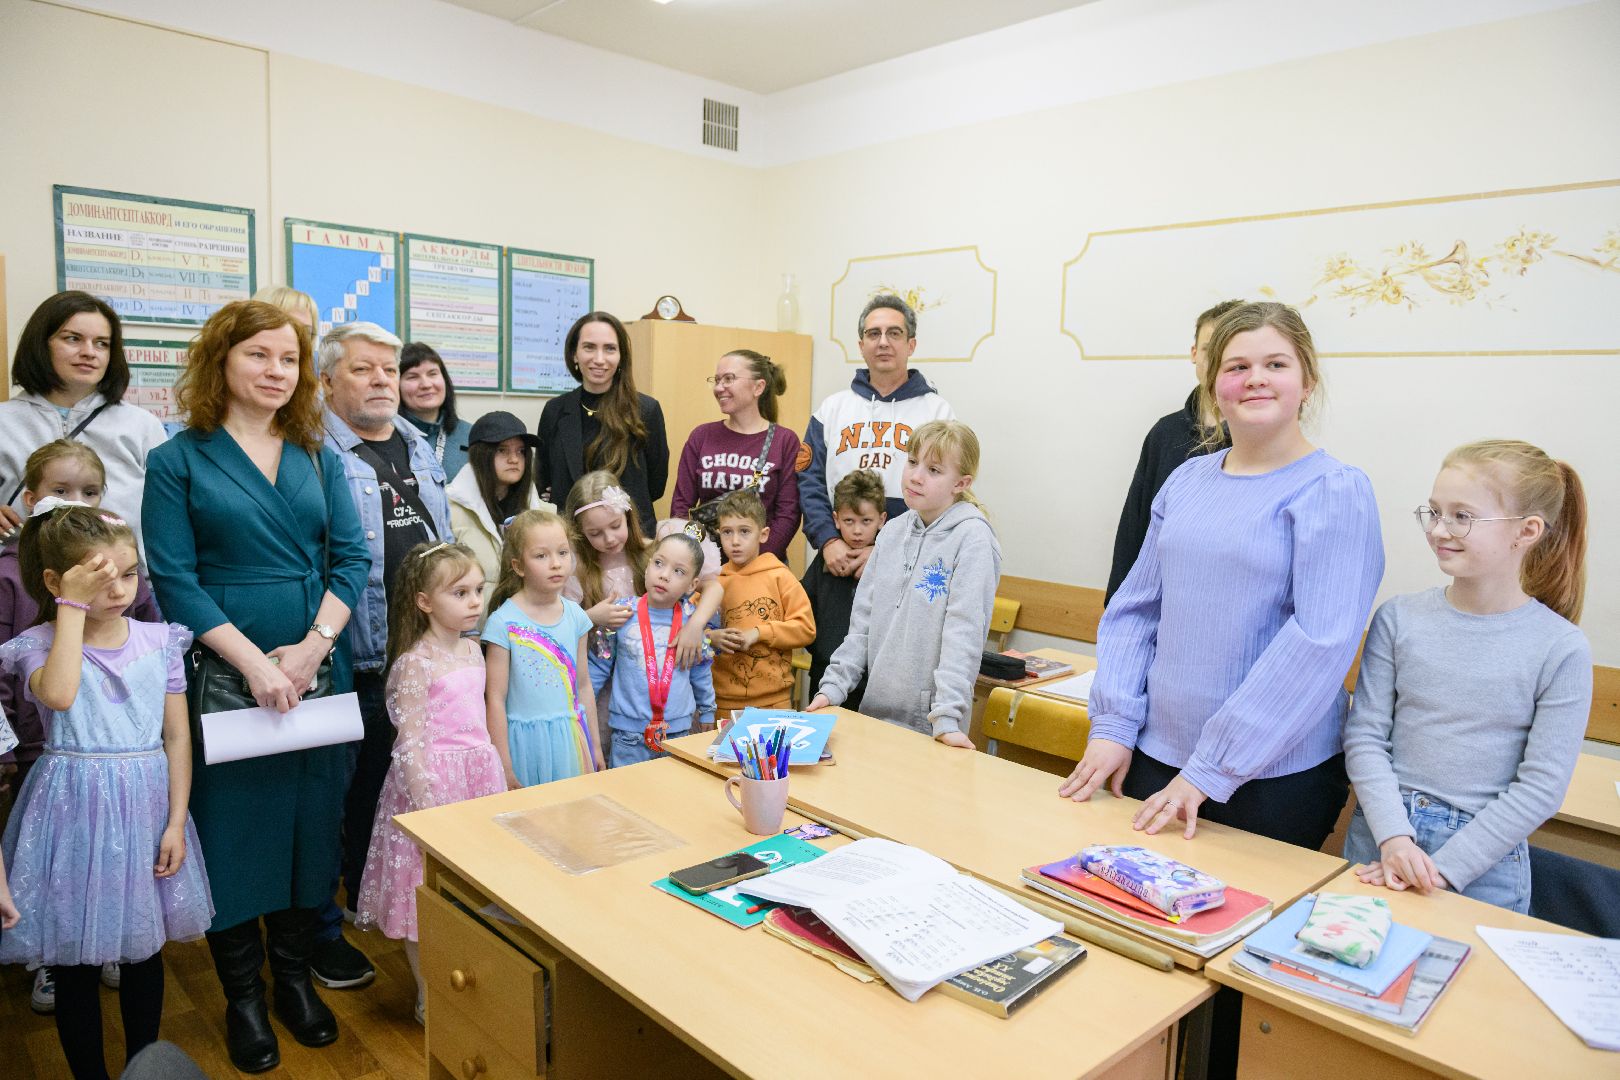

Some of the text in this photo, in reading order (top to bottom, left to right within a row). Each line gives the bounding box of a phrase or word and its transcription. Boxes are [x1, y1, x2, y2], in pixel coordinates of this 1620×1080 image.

[67, 201, 173, 228] ДОМИНАНТСЕПТАККОРД
[183, 221, 198, 230] ЕГО
[200, 222, 246, 235] ОБРАЩЕНИЯ
[67, 227, 122, 241] НАЗВАНИЕ
[306, 229, 385, 252] ГАММА
[421, 244, 490, 260] АККОРДЫ
[179, 271, 196, 284] VII
[124, 348, 170, 363] ЕРНЫЕ
[859, 453, 892, 469] GAP
[701, 471, 771, 493] HAPPY
